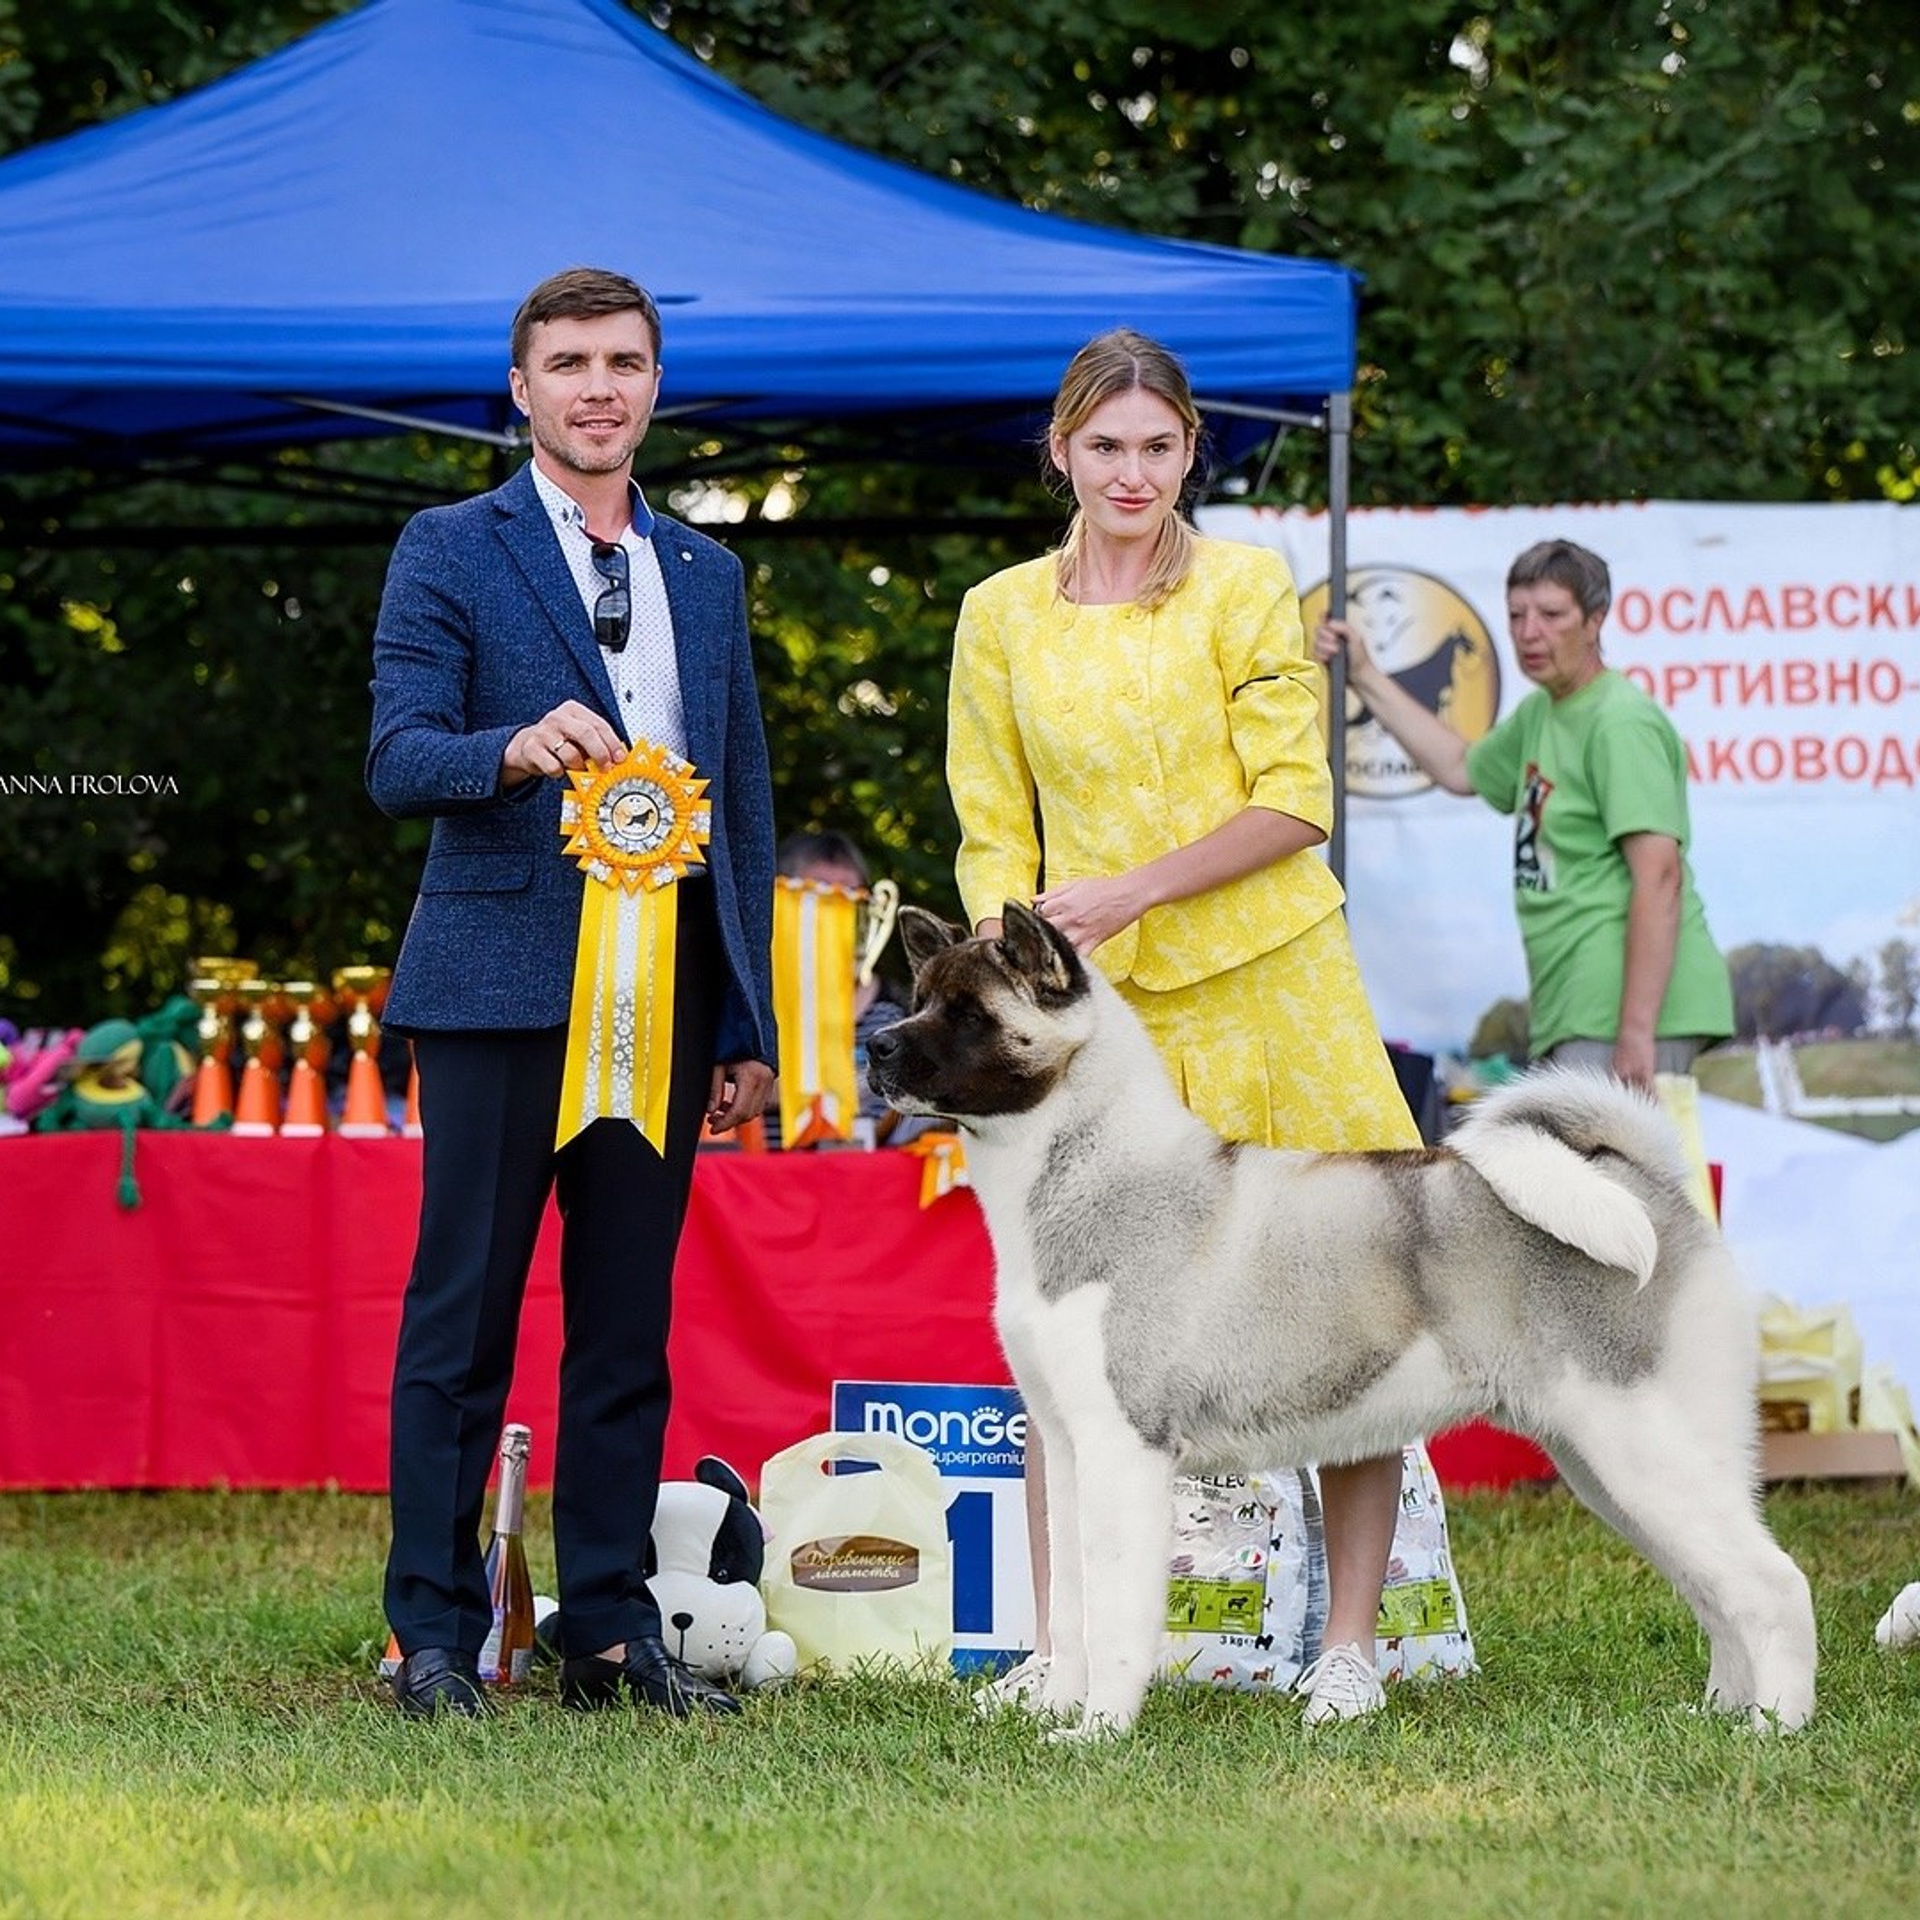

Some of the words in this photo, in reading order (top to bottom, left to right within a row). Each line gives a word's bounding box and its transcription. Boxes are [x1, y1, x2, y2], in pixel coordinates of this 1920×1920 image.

[1685, 736, 1920, 789] КОВОД
[804, 1549, 906, 1570] Деревенские
[810, 1566, 900, 1580] лакомства
[945, 1492, 993, 1634] 1
